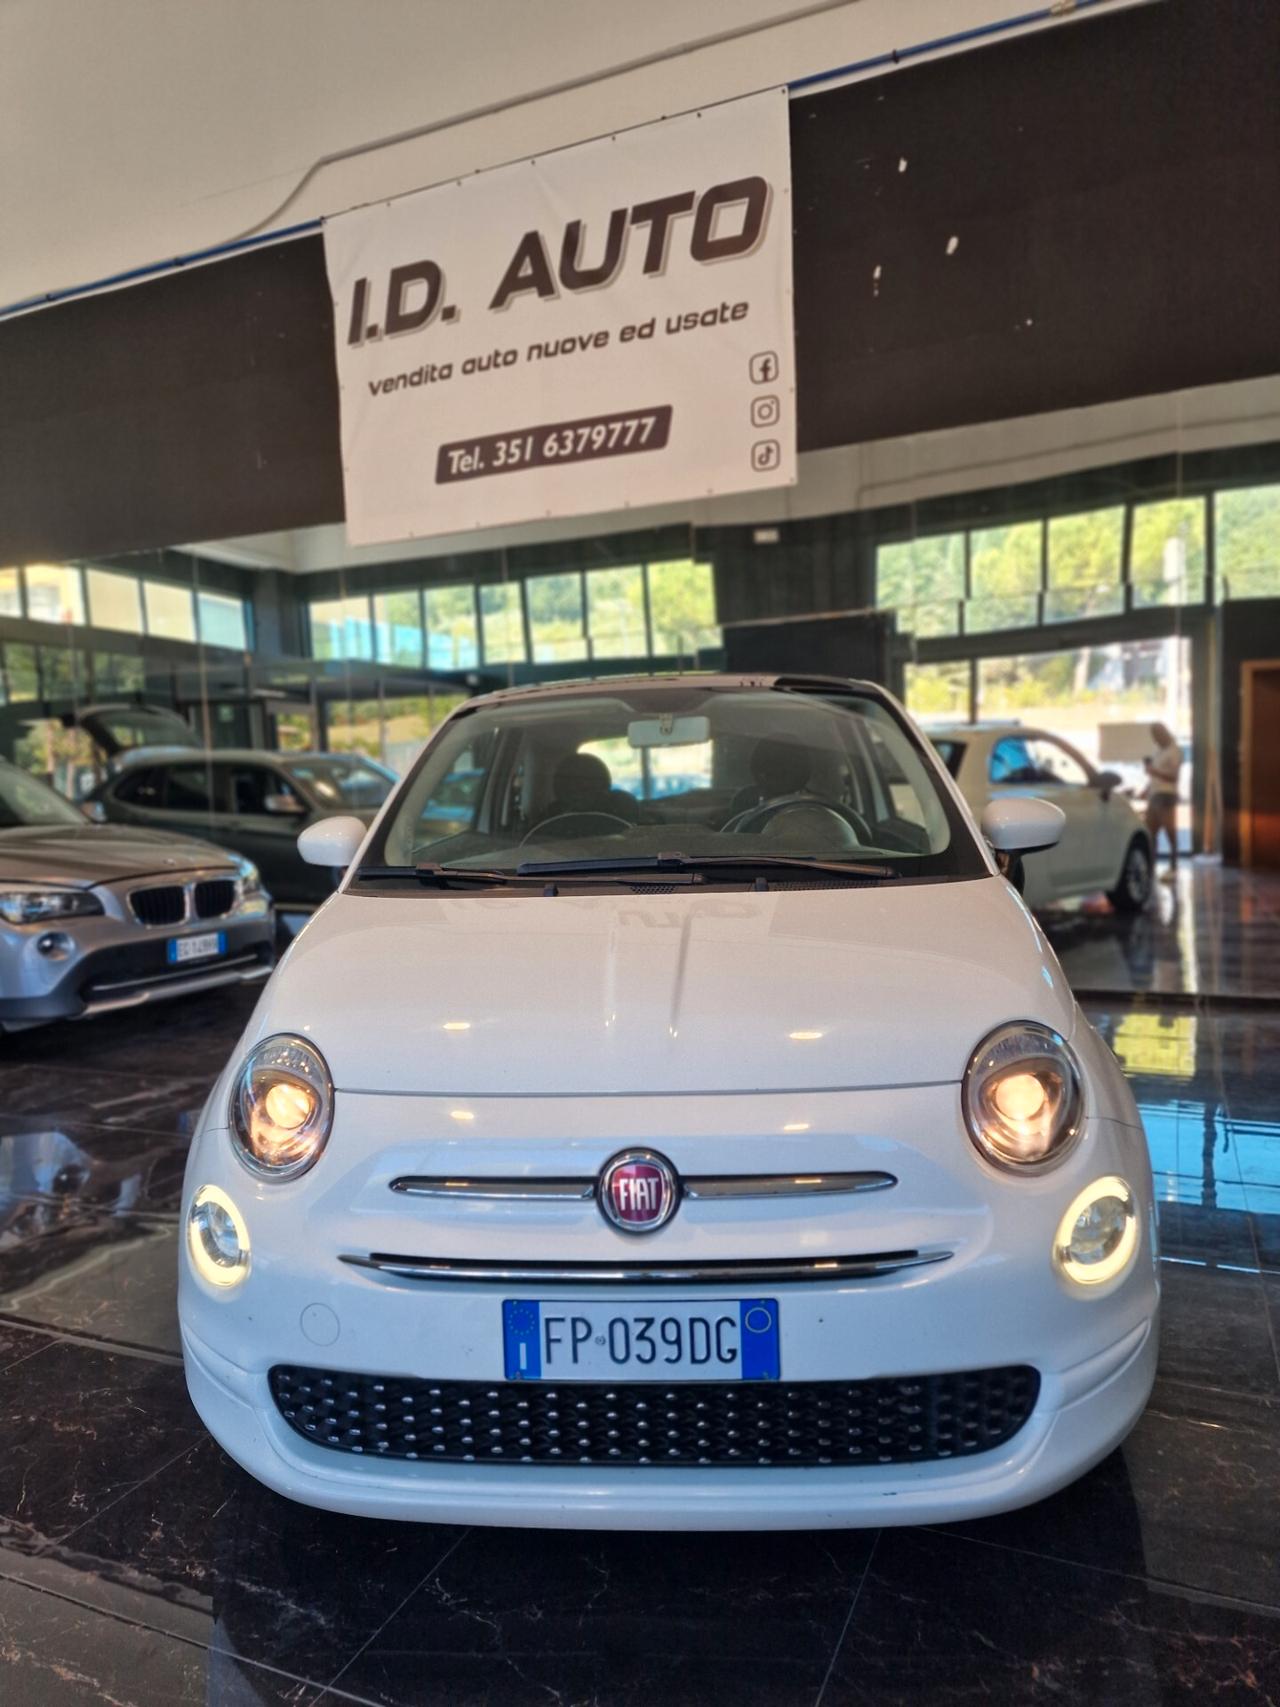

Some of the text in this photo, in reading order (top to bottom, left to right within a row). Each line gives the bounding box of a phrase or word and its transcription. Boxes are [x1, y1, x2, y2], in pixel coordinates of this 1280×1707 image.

[347, 175, 773, 347] I.D. AUTO
[368, 301, 749, 396] vendita auto nuove ed usate
[447, 416, 656, 474] Tel. 351 6379777
[618, 1177, 660, 1211] FIAT
